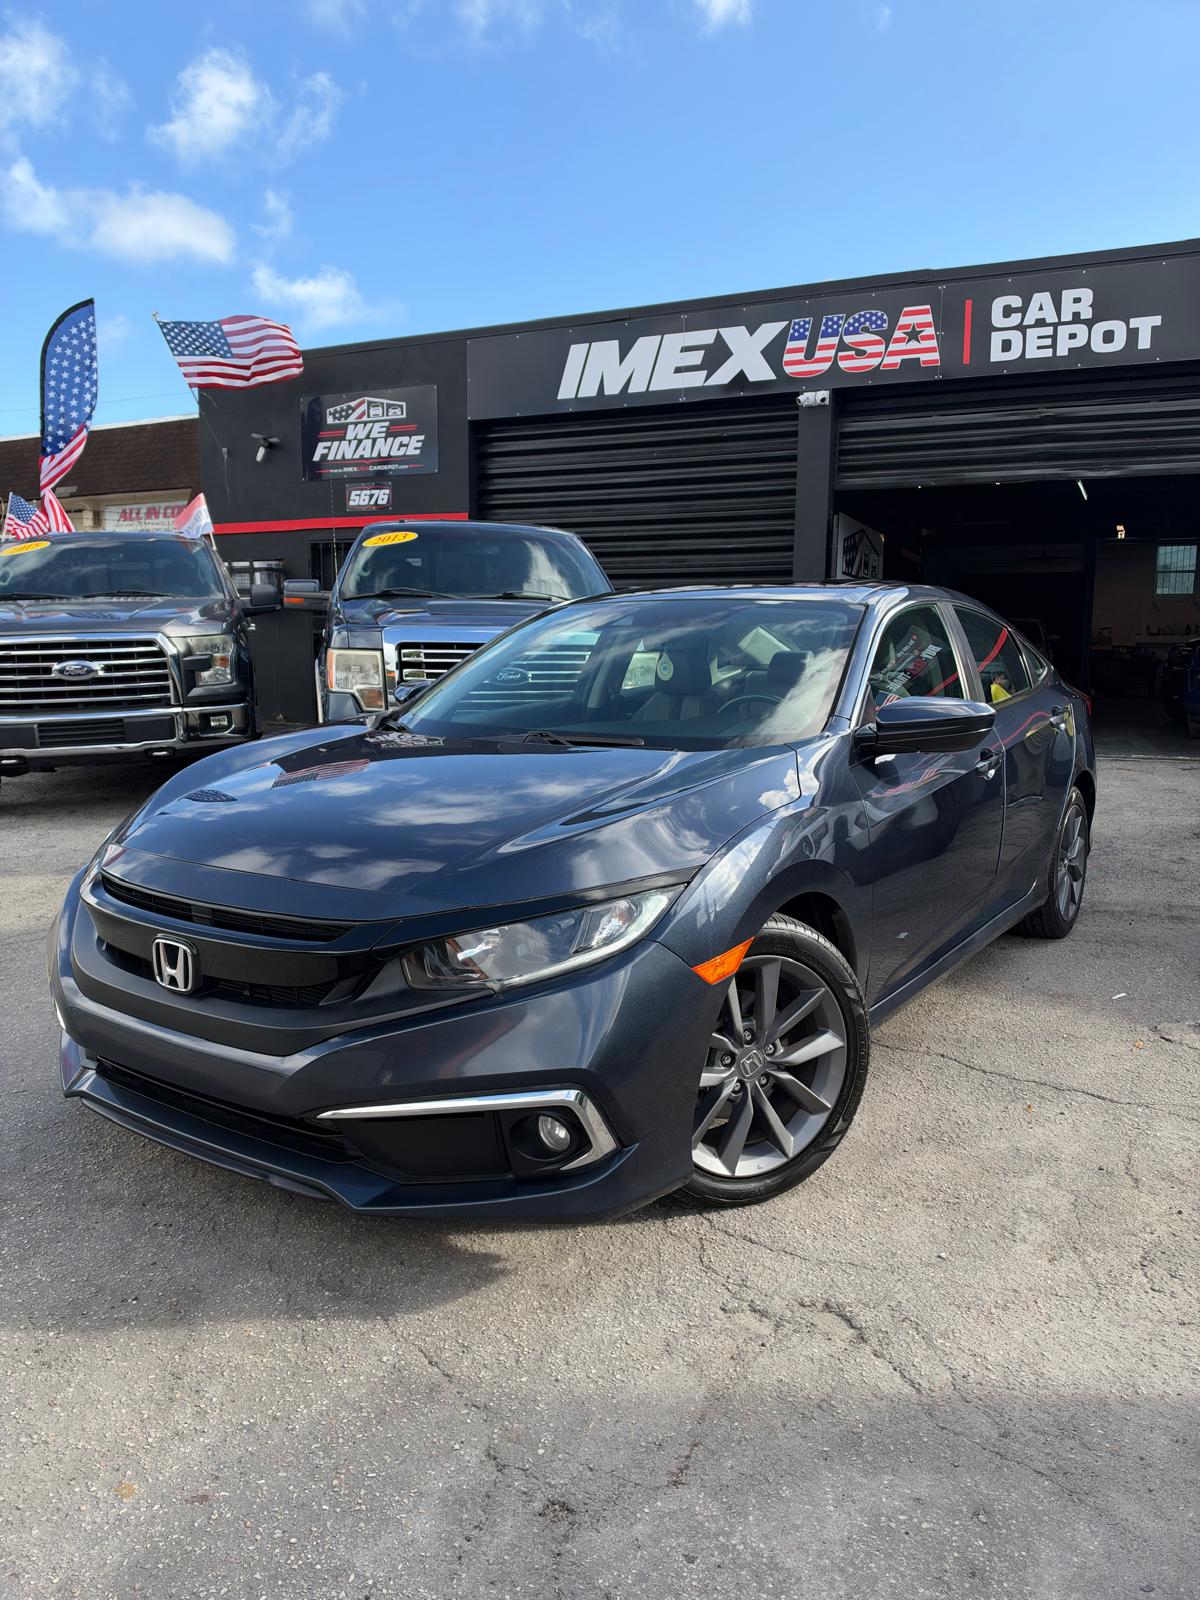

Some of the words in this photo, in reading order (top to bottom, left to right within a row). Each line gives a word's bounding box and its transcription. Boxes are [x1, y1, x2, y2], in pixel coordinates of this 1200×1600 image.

[991, 288, 1094, 328] CAR
[990, 315, 1162, 362] DEPOT
[345, 421, 389, 440] WE
[312, 435, 425, 461] FINANCE
[349, 489, 389, 506] 5676
[119, 507, 142, 522] ALL
[145, 505, 159, 520] IN
[64, 665, 87, 675] Ford
[496, 671, 521, 681] Ford
